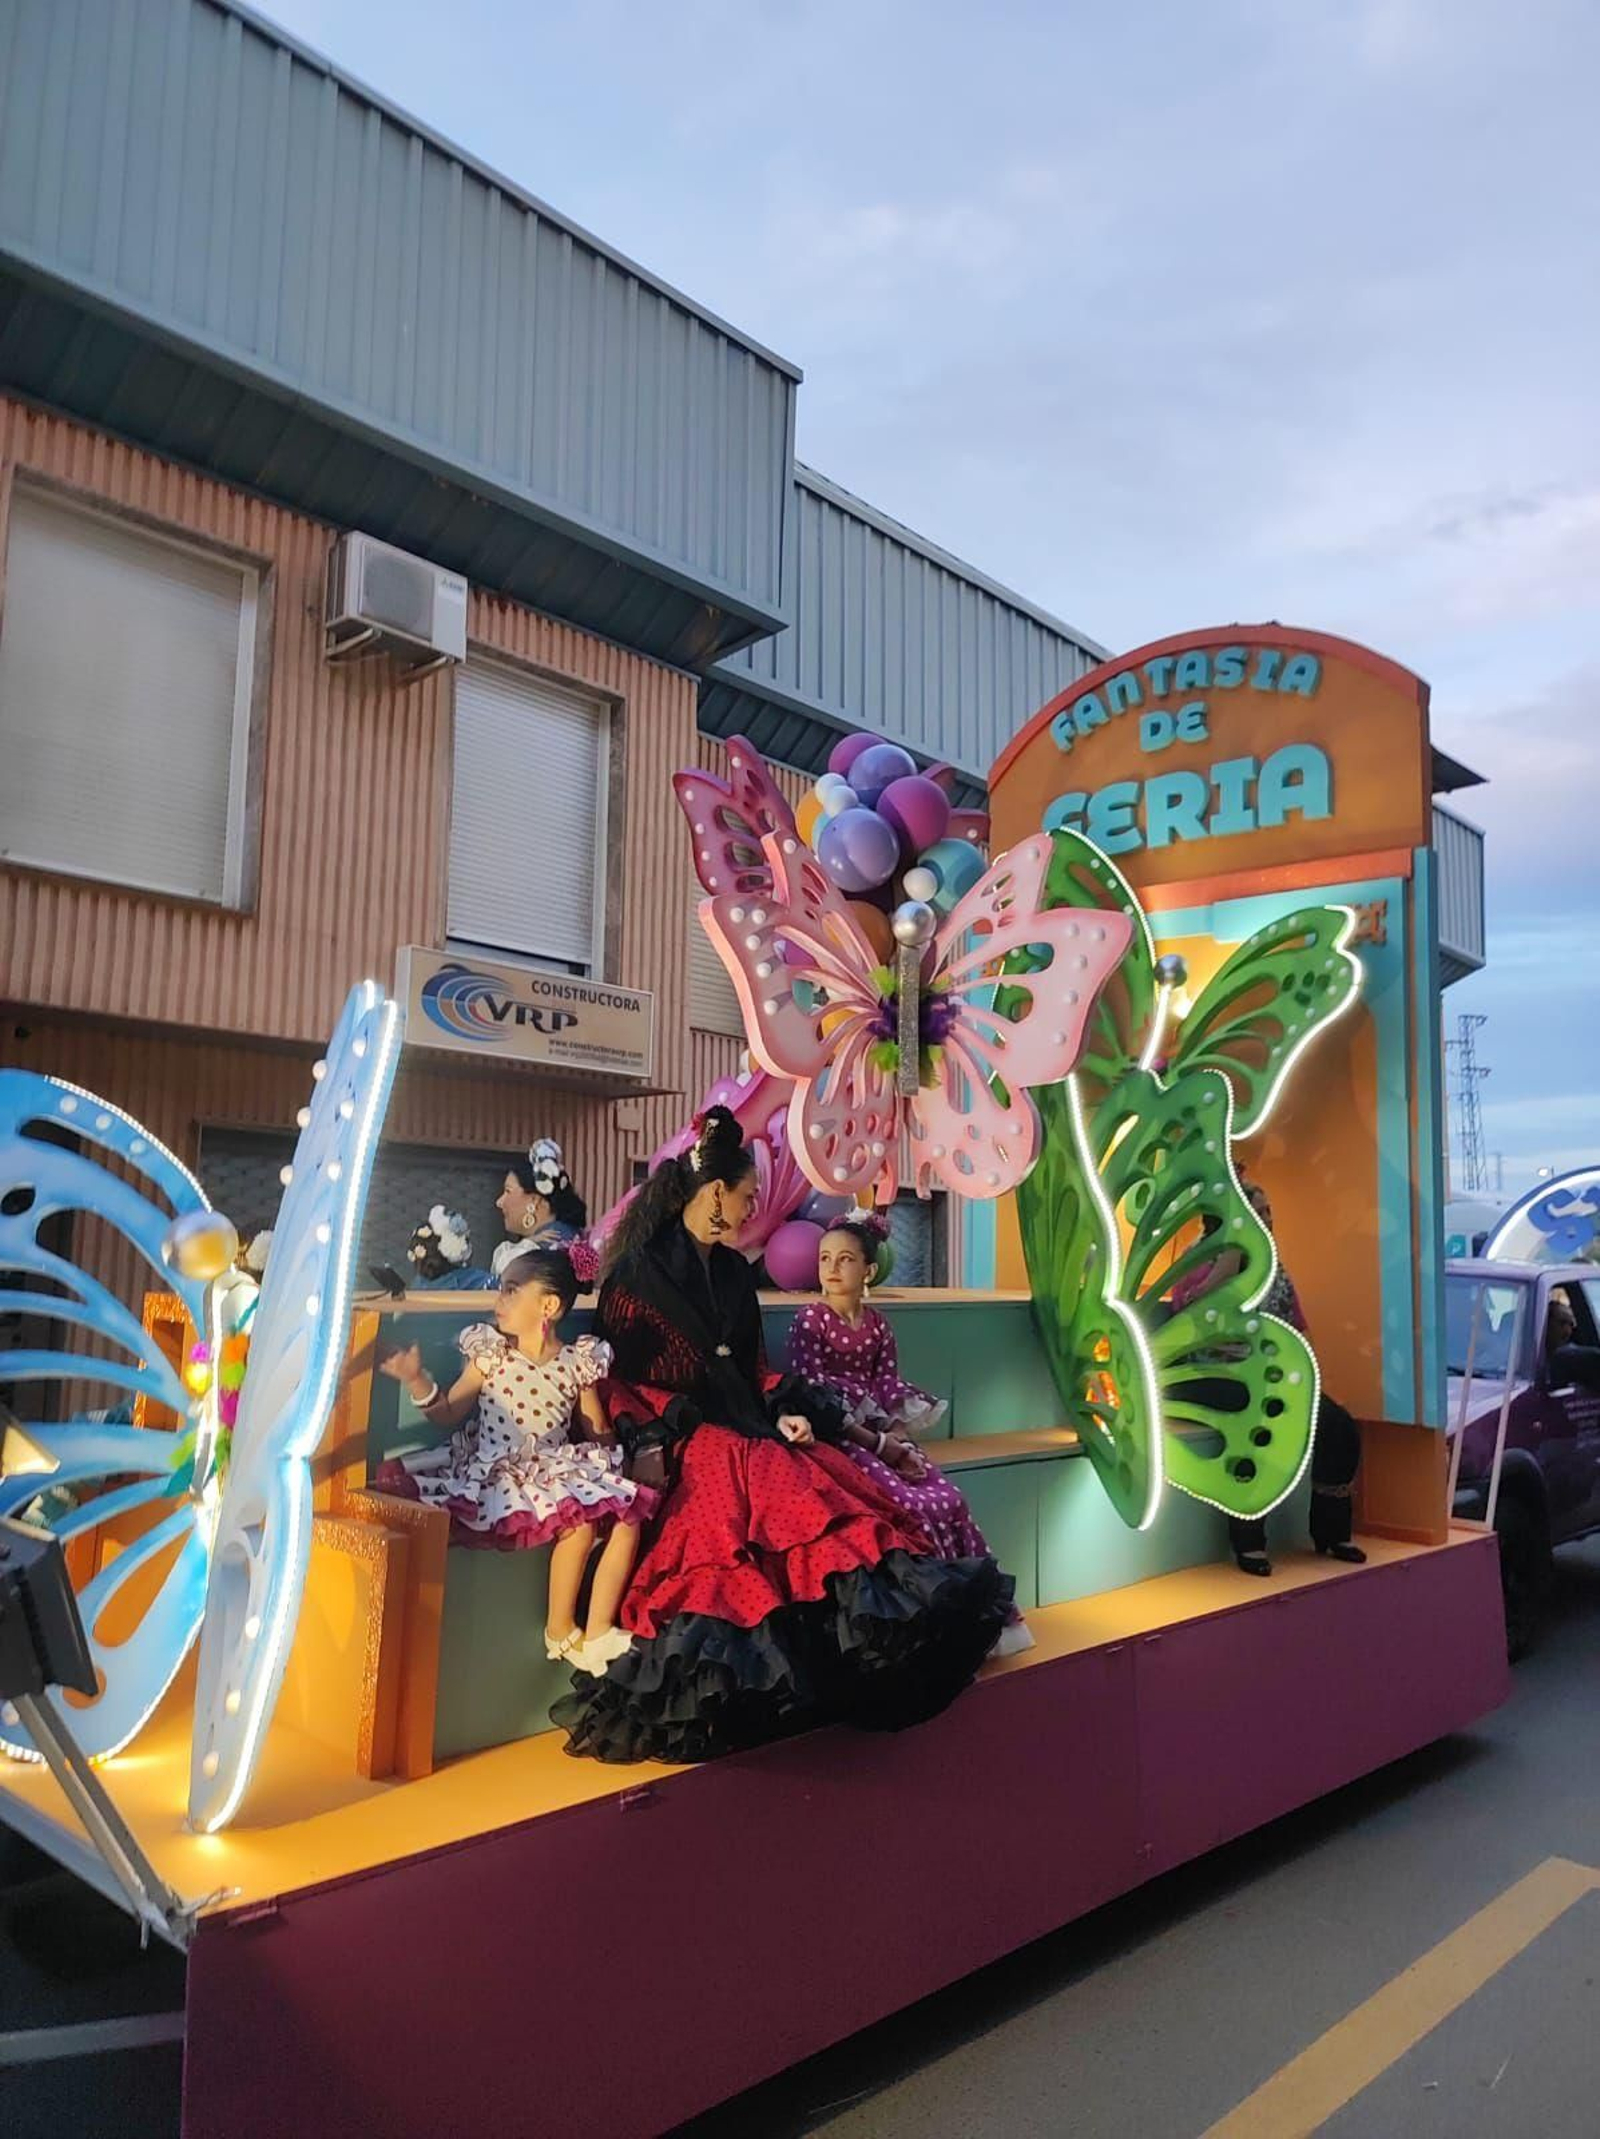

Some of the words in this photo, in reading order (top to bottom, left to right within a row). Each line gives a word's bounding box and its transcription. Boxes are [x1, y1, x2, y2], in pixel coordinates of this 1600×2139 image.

[1048, 646, 1322, 754] FANTASIA
[1139, 702, 1209, 753] DE
[483, 994, 579, 1034] VRP
[531, 980, 641, 1012] CONSTRUCTORA
